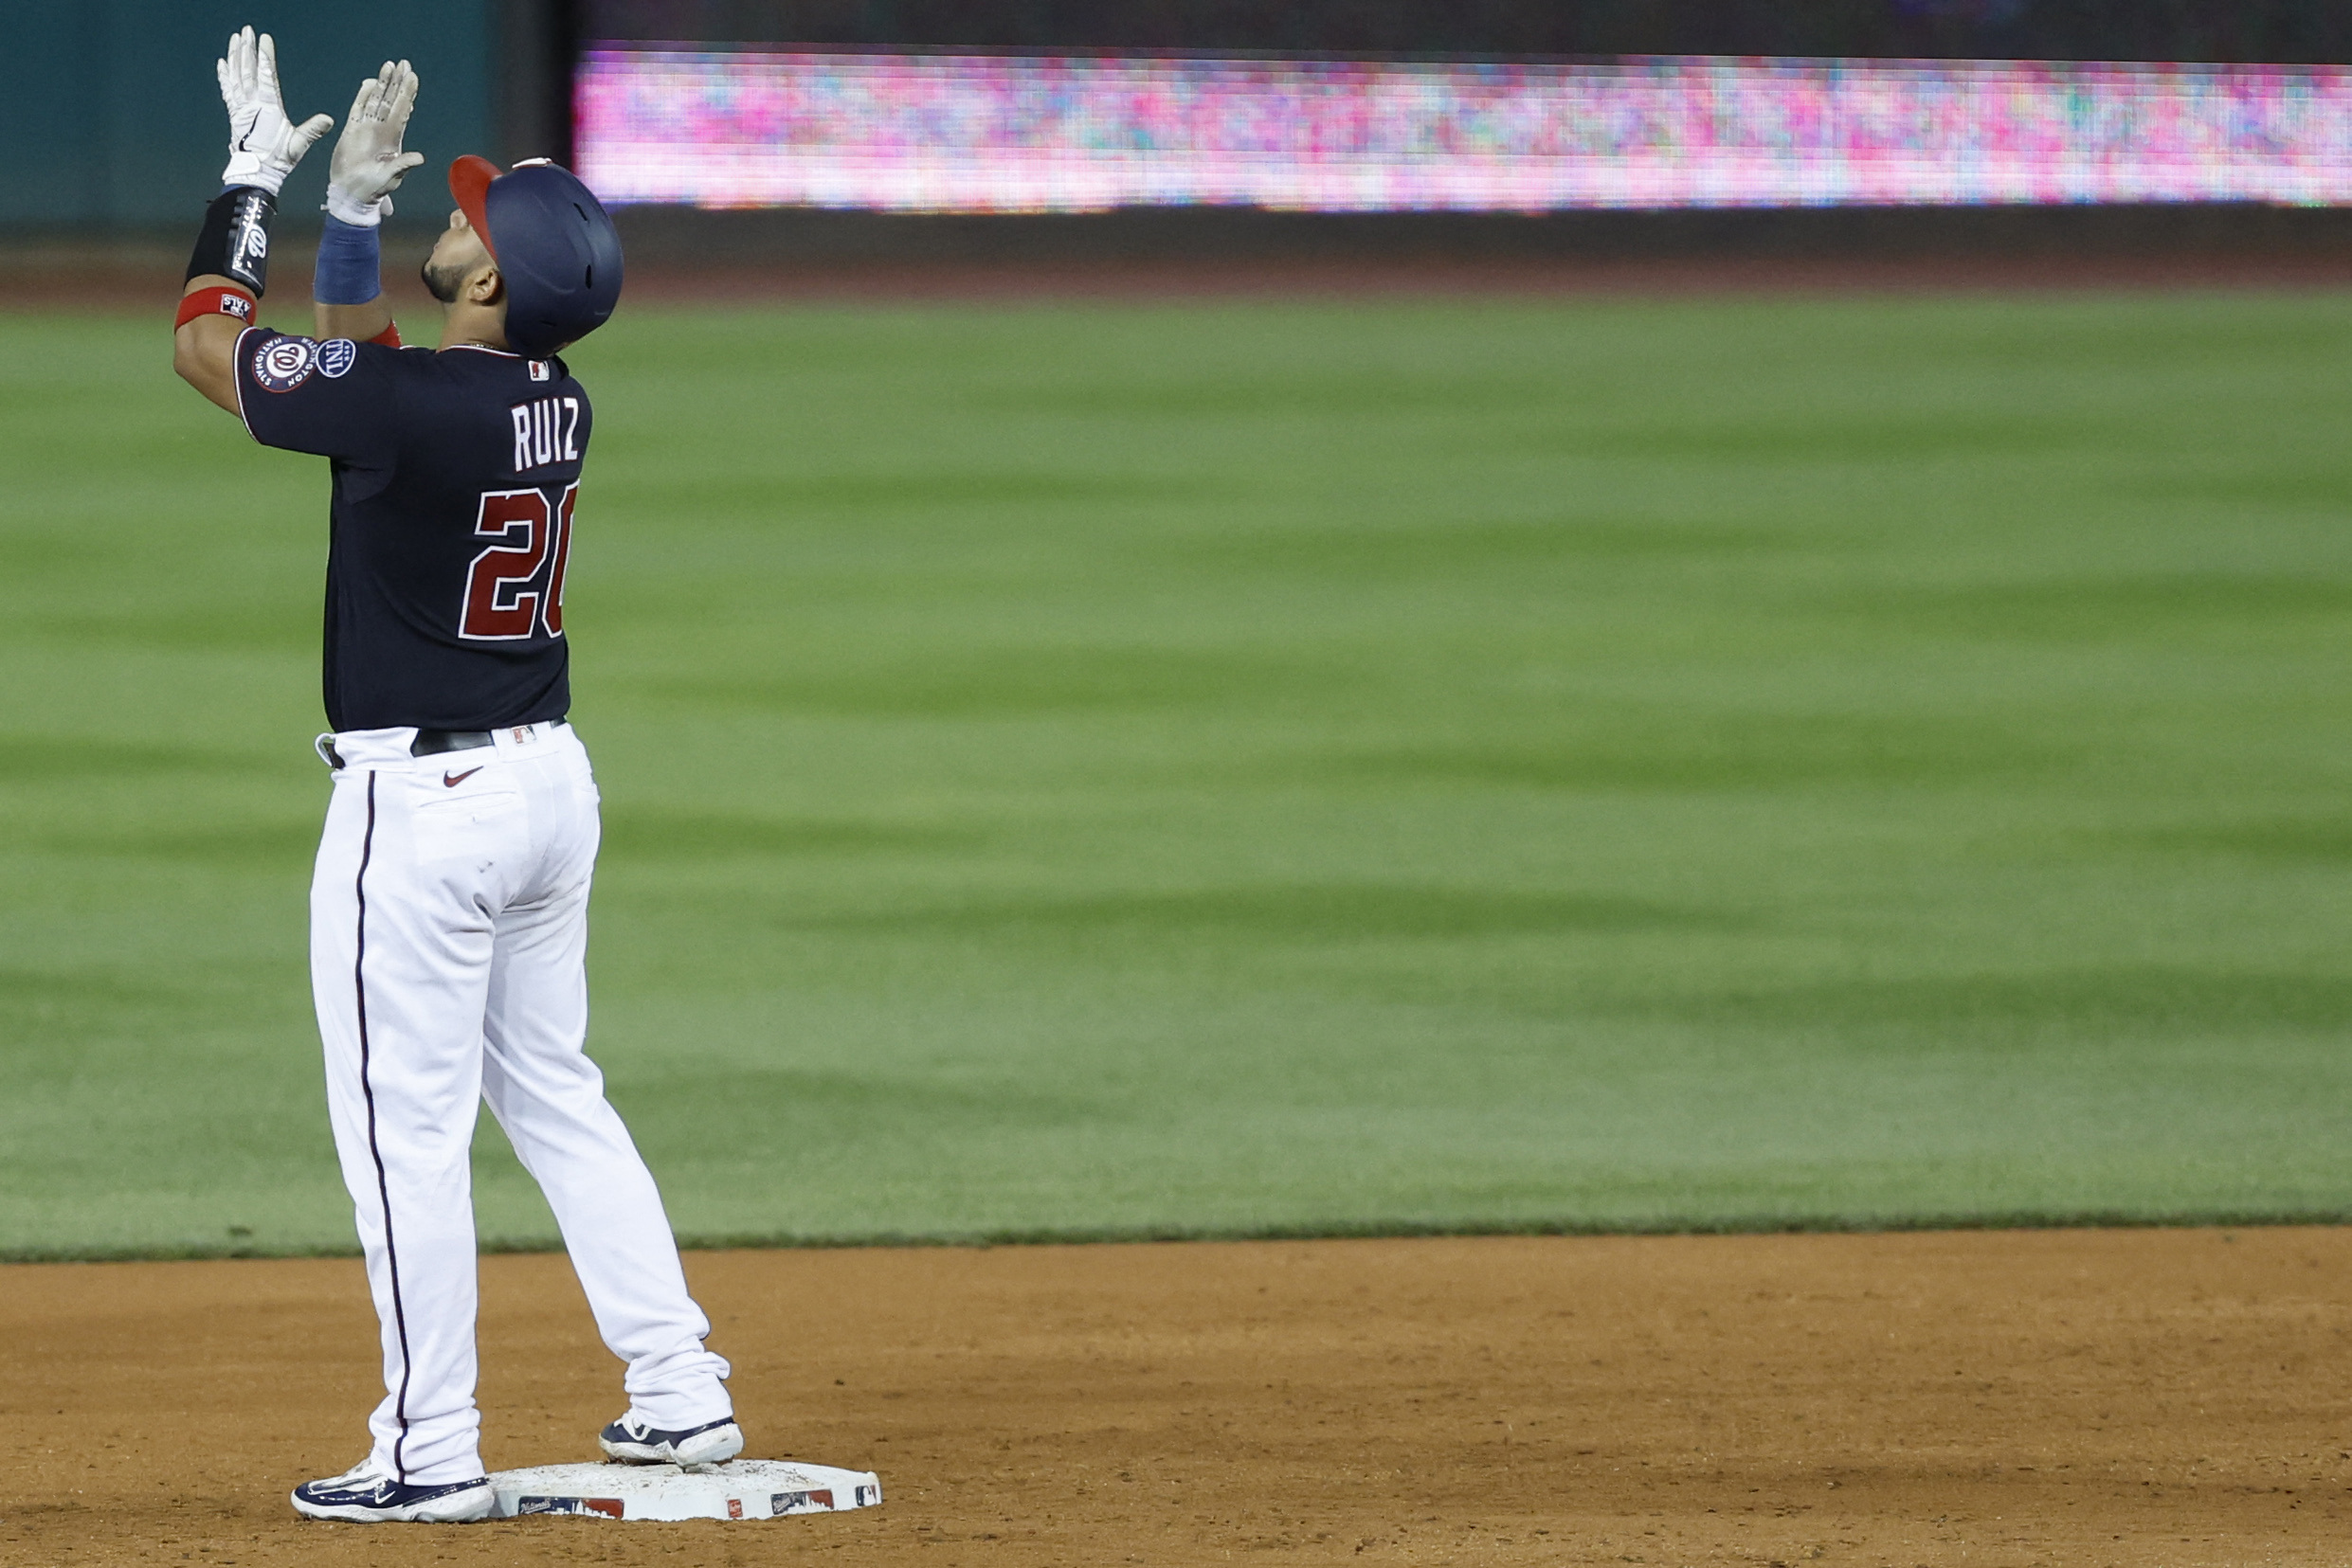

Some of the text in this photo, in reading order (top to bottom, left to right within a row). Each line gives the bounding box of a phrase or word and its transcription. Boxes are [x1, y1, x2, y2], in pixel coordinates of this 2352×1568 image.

[255, 336, 282, 387] NATIONALS
[326, 340, 344, 375] TNL
[511, 396, 579, 473] RUIZ
